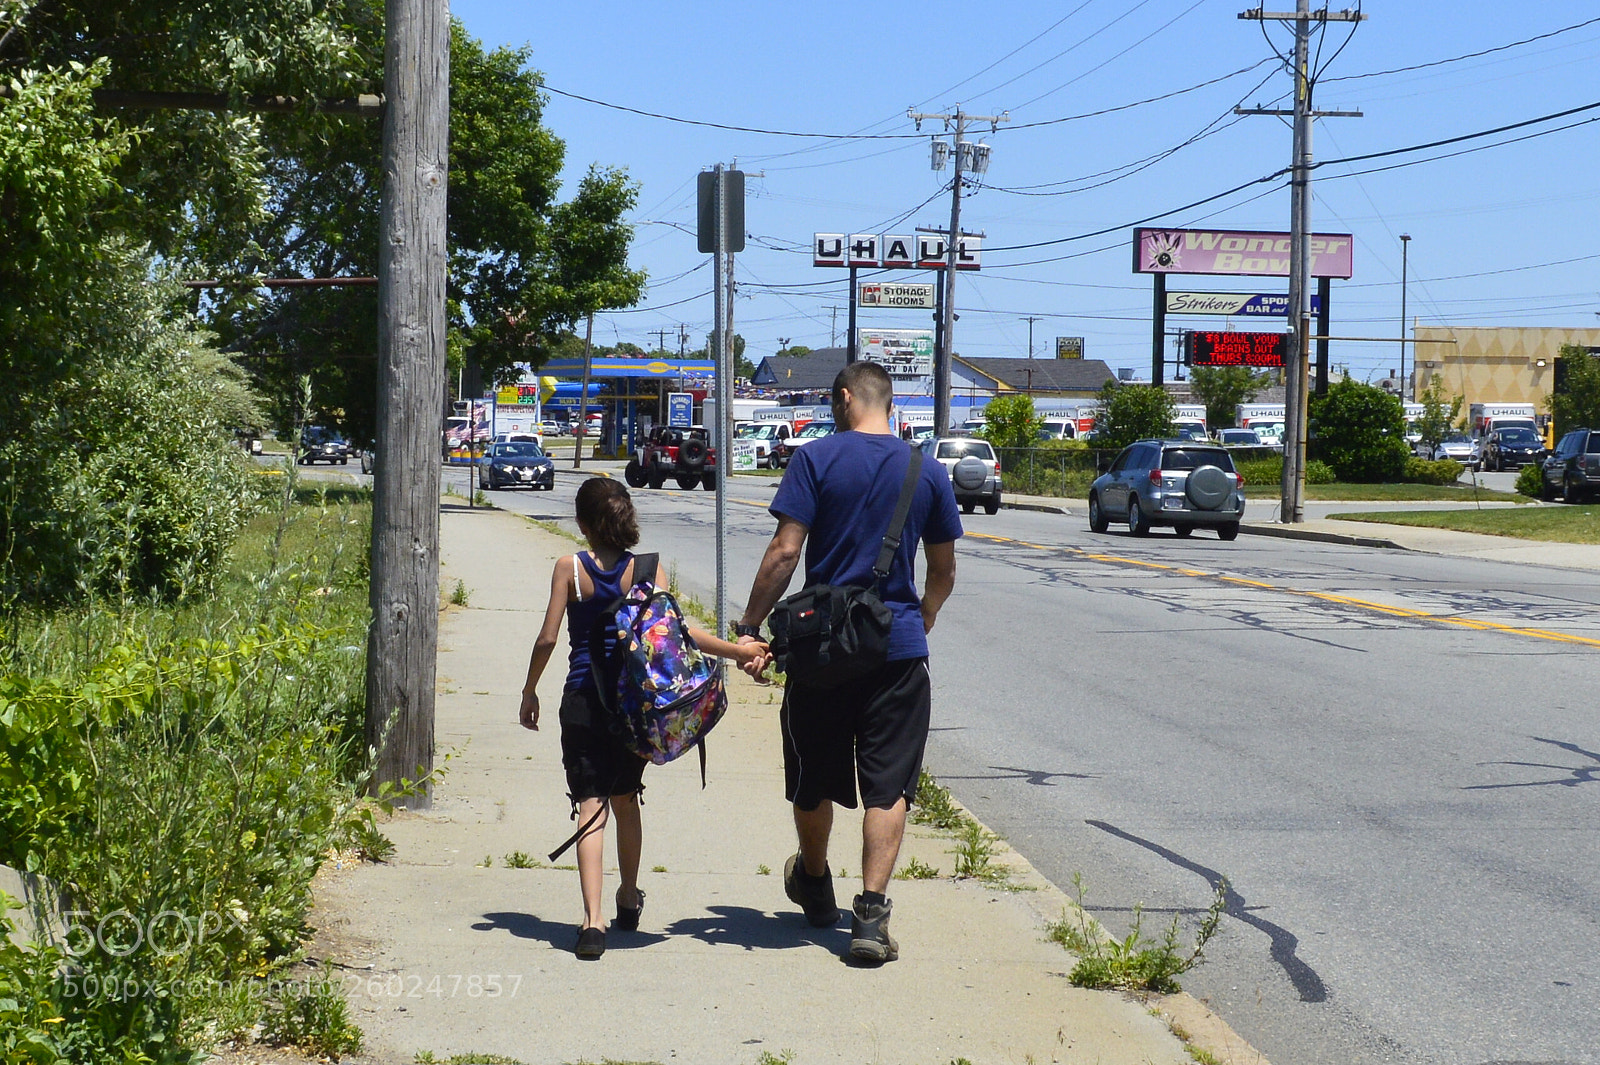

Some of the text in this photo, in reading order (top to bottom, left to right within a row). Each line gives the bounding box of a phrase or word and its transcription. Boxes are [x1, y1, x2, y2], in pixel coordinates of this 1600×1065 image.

[884, 287, 931, 297] STORAGE
[888, 296, 925, 305] ROOMS
[1167, 294, 1240, 311] Strikers
[1246, 305, 1270, 313] BAR
[1223, 334, 1250, 344] BOWL
[1254, 344, 1275, 353] OUT
